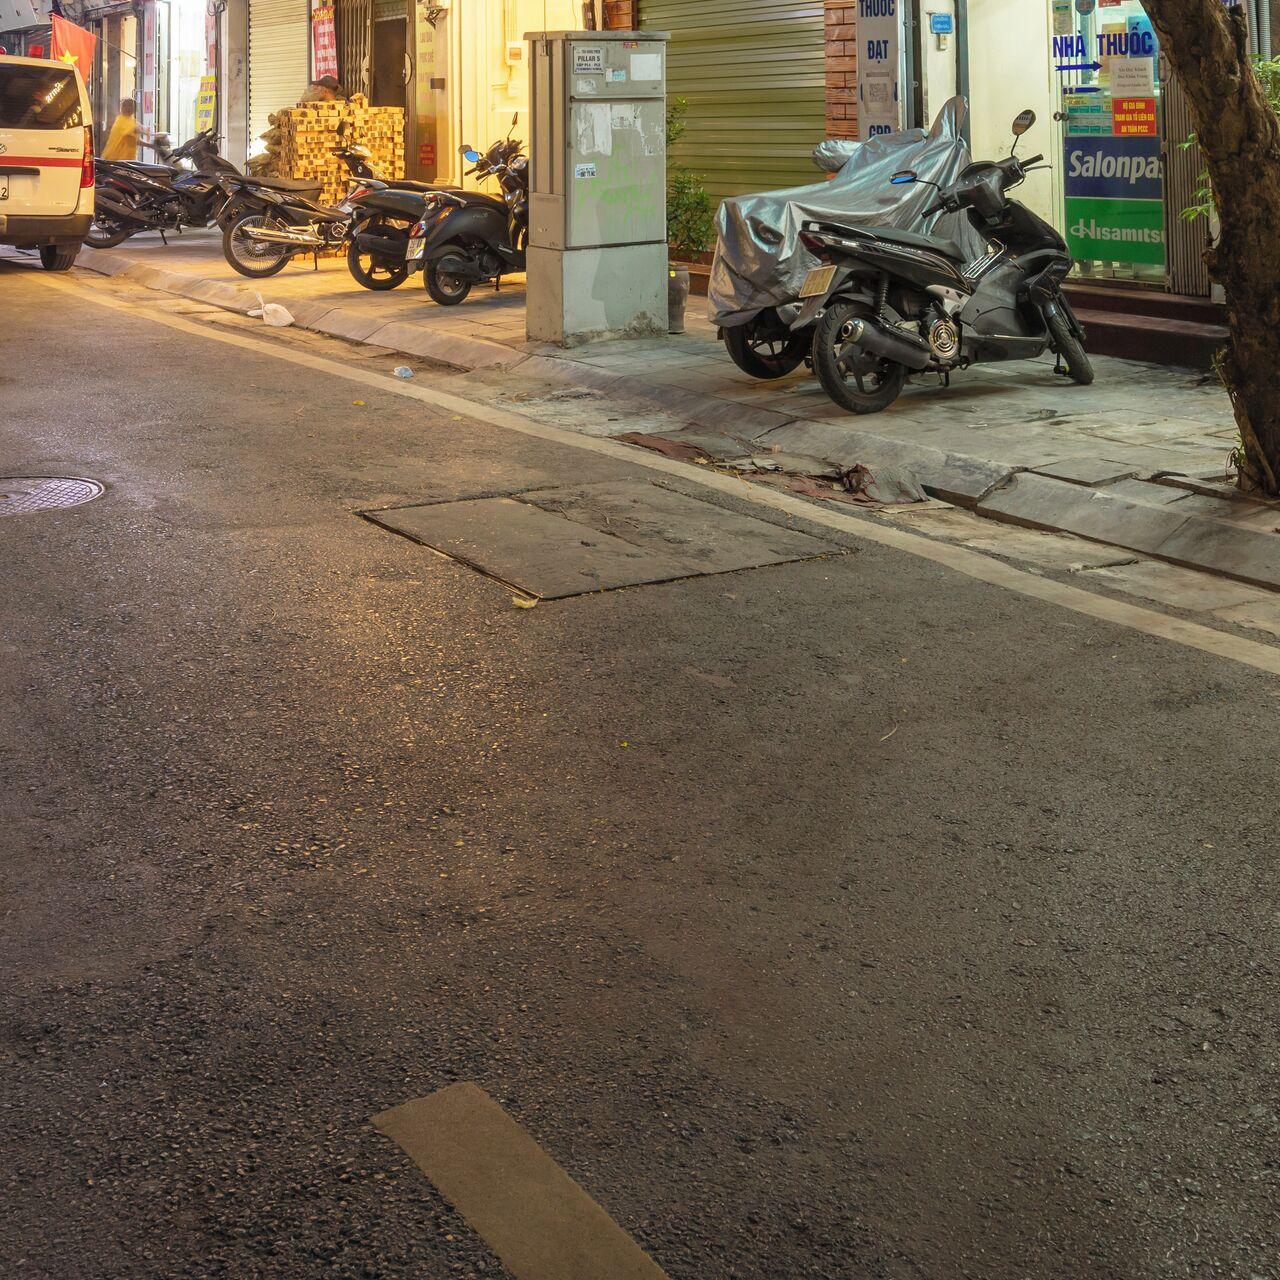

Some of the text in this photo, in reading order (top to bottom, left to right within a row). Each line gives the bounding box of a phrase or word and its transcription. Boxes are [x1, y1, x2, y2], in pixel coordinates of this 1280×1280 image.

[867, 39, 889, 65] ĐẠT
[1052, 21, 1153, 58] NHÀ THUỐC
[1070, 218, 1164, 243] Hisamits
